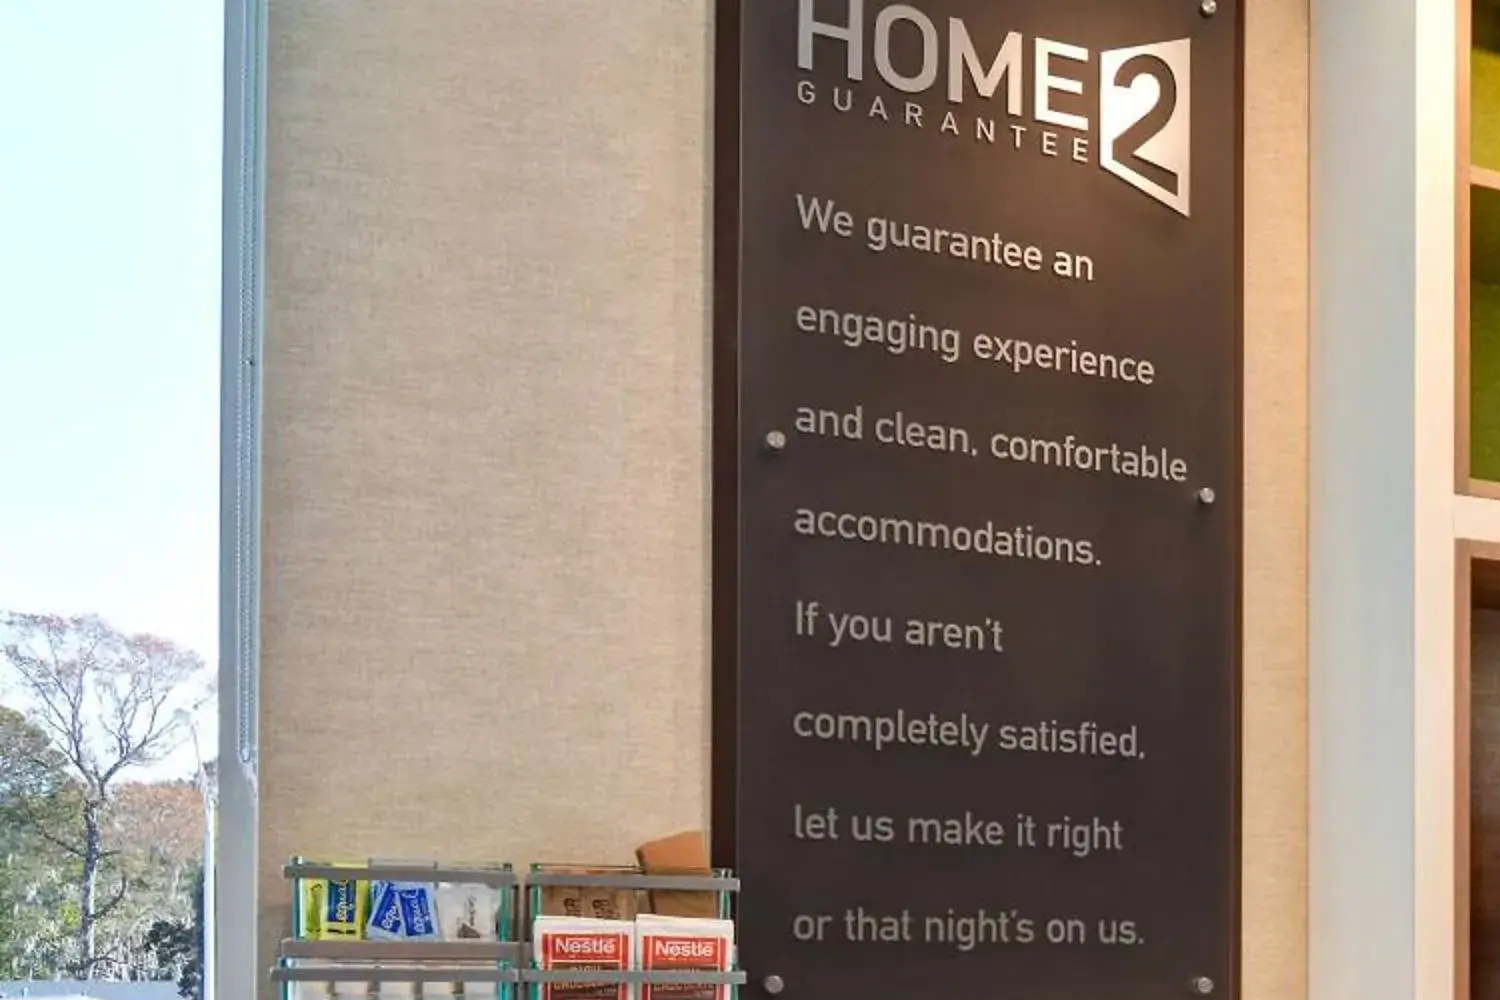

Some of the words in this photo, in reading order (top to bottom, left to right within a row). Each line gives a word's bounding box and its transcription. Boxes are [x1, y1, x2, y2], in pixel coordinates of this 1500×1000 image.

[798, 80, 1090, 163] GUARANTEE
[796, 193, 854, 237] We
[867, 217, 1042, 271] guarantee
[1053, 251, 1094, 281] an
[796, 305, 961, 363] engaging
[973, 333, 1155, 385] experience
[795, 405, 863, 440] and
[991, 433, 1188, 482] comfortable
[794, 508, 1102, 566] accommodations.
[796, 600, 819, 637] If
[827, 612, 892, 647] you
[905, 617, 1004, 652] aren't
[793, 708, 989, 756] completely
[794, 803, 839, 840] let
[851, 815, 895, 842] us
[908, 811, 1004, 846] make
[1017, 813, 1036, 848] it
[1047, 815, 1123, 858] right
[793, 914, 833, 941] or
[844, 906, 912, 942] that
[925, 908, 1035, 952] night's
[1046, 918, 1086, 944] on
[1098, 919, 1145, 945] us.
